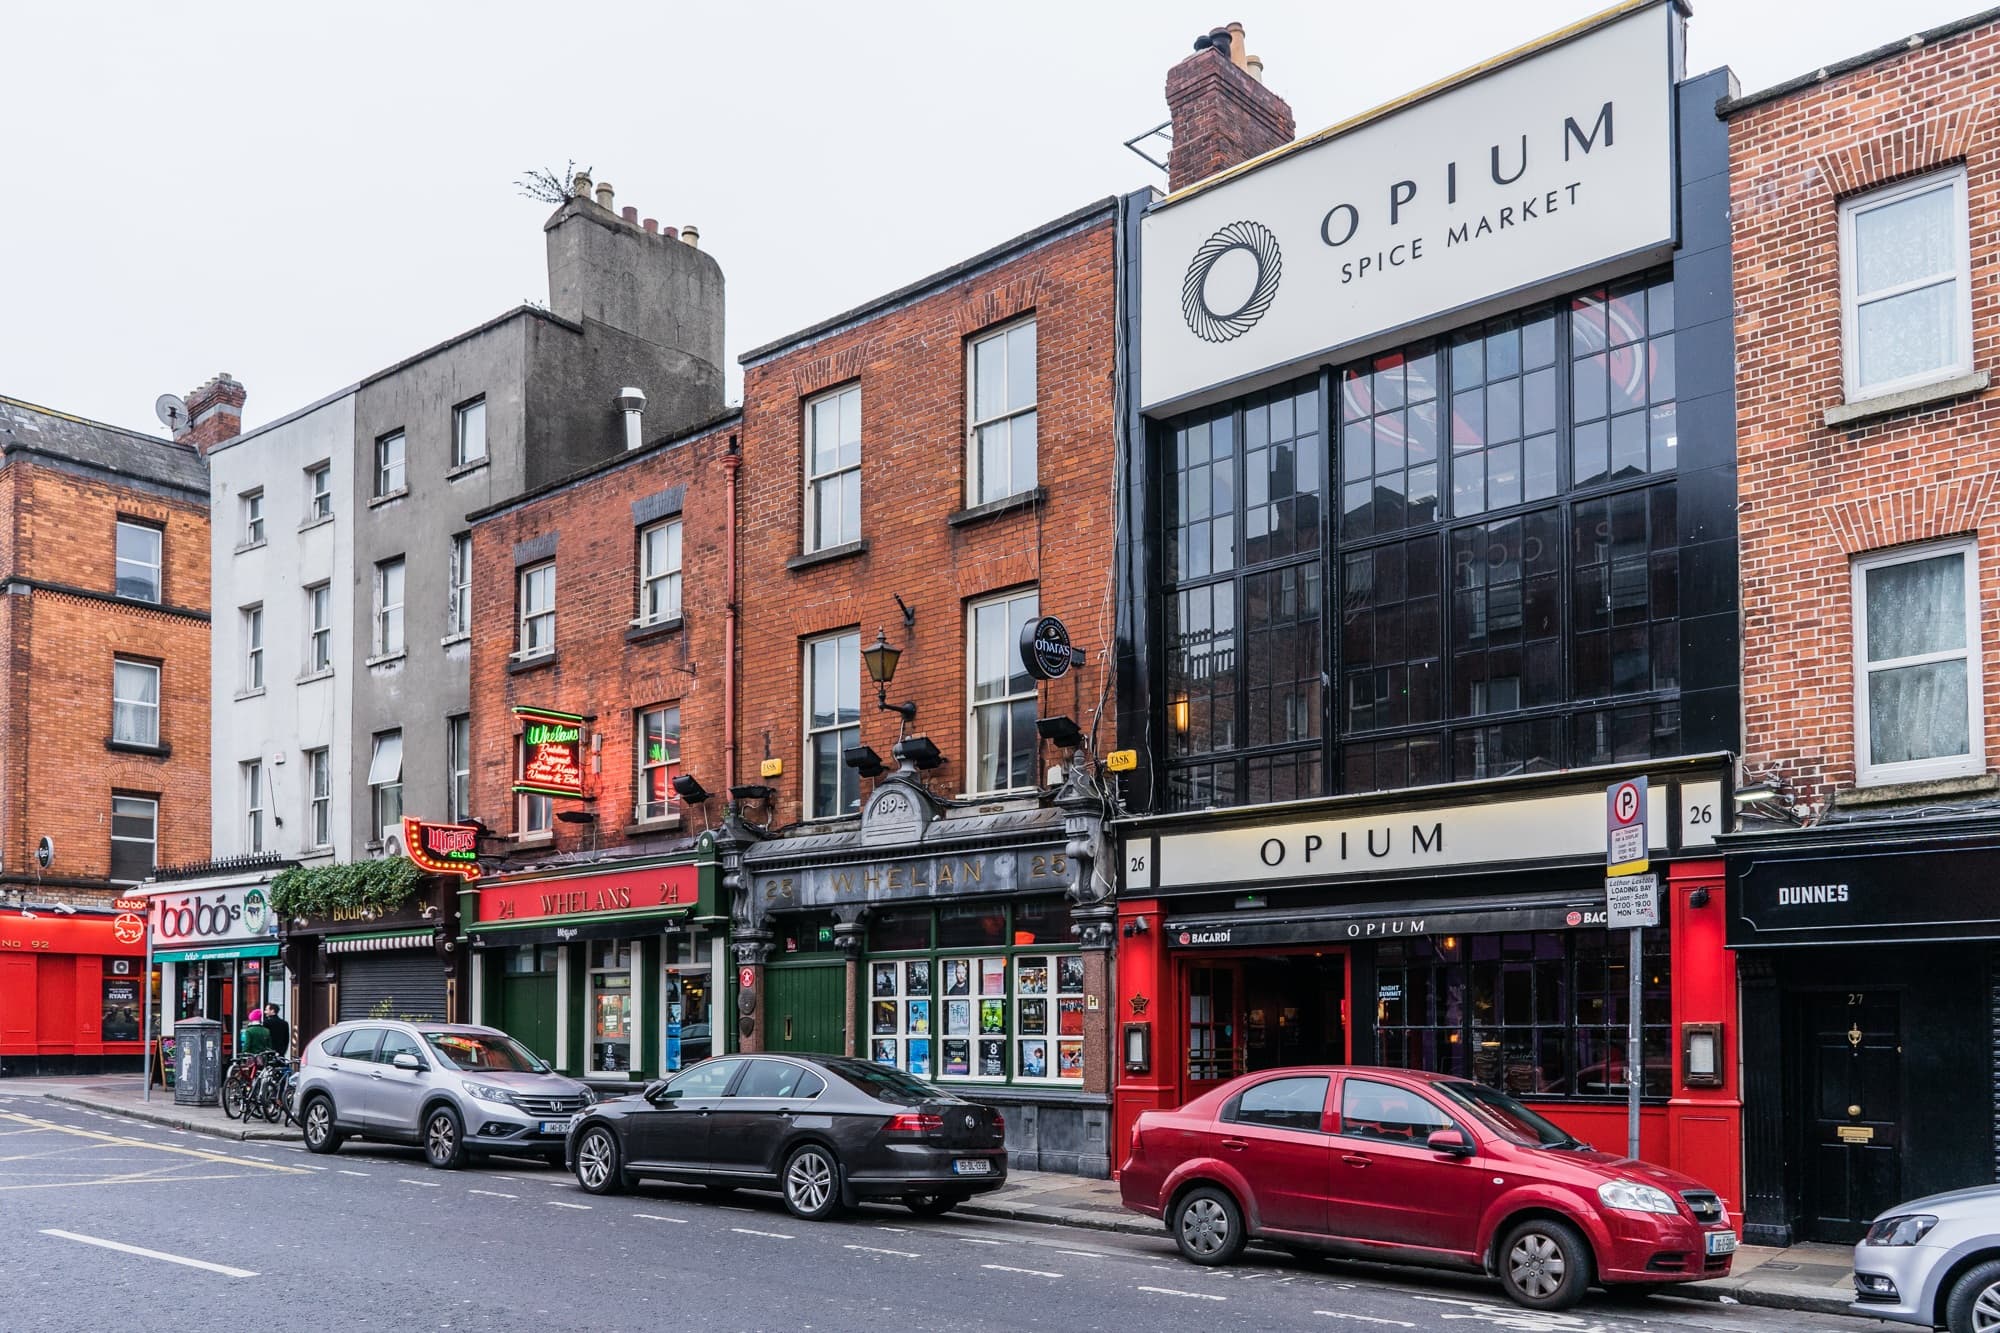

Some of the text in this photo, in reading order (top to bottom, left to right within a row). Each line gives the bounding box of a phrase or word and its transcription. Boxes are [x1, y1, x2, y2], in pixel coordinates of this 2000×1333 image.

[1320, 101, 1614, 248] OPIUM
[1341, 182, 1582, 285] SPICE MARKET
[526, 724, 579, 745] Whelans
[1111, 756, 1129, 764] TASK
[877, 800, 908, 815] 1894
[1690, 804, 1712, 824] 26
[1260, 822, 1444, 867] OPIUM
[451, 851, 476, 859] CLUB
[1130, 856, 1144, 872] 26
[1030, 853, 1067, 878] 25
[829, 860, 982, 893] WHELAN
[539, 886, 631, 914] WHELANS
[658, 882, 680, 905] 24
[765, 879, 793, 901] 25
[1611, 886, 1638, 894] LOADING
[1778, 884, 1849, 905] DUNNES
[498, 899, 515, 920] 24
[1617, 909, 1632, 917] MON
[1348, 920, 1426, 938] OPIUM
[31, 940, 49, 949] 92
[1848, 993, 1864, 1006] 27
[990, 1043, 998, 1054] 8
